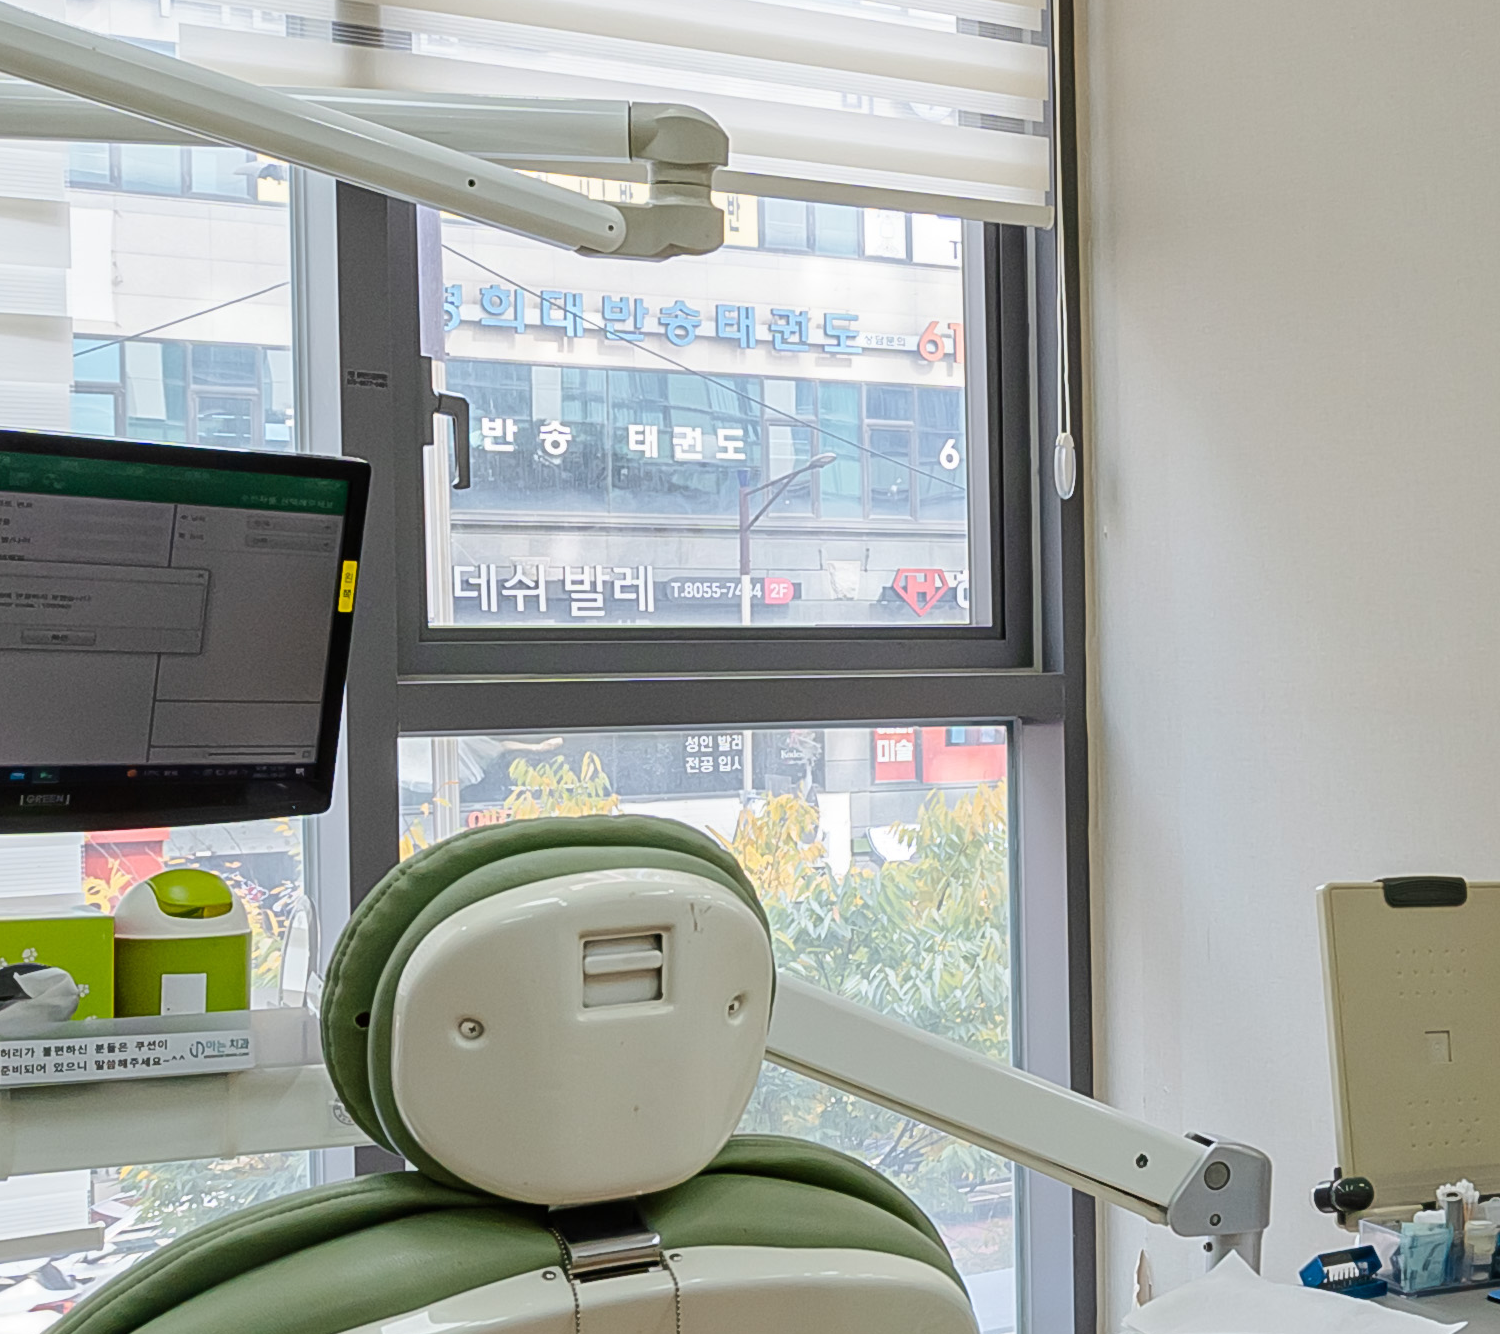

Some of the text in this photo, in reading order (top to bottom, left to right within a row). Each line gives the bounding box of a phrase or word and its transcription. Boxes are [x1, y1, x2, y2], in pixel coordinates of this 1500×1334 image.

[564, 563, 655, 617] 발레
[769, 583, 789, 599] 2F
[685, 735, 713, 753] 성인
[876, 738, 914, 763] 미술
[685, 756, 715, 773] 전공
[0, 1038, 168, 1059] 허리가 불편하신 분들은 쿠션이
[0, 1064, 47, 1077] 준비되어
[53, 1060, 88, 1073] 있으니
